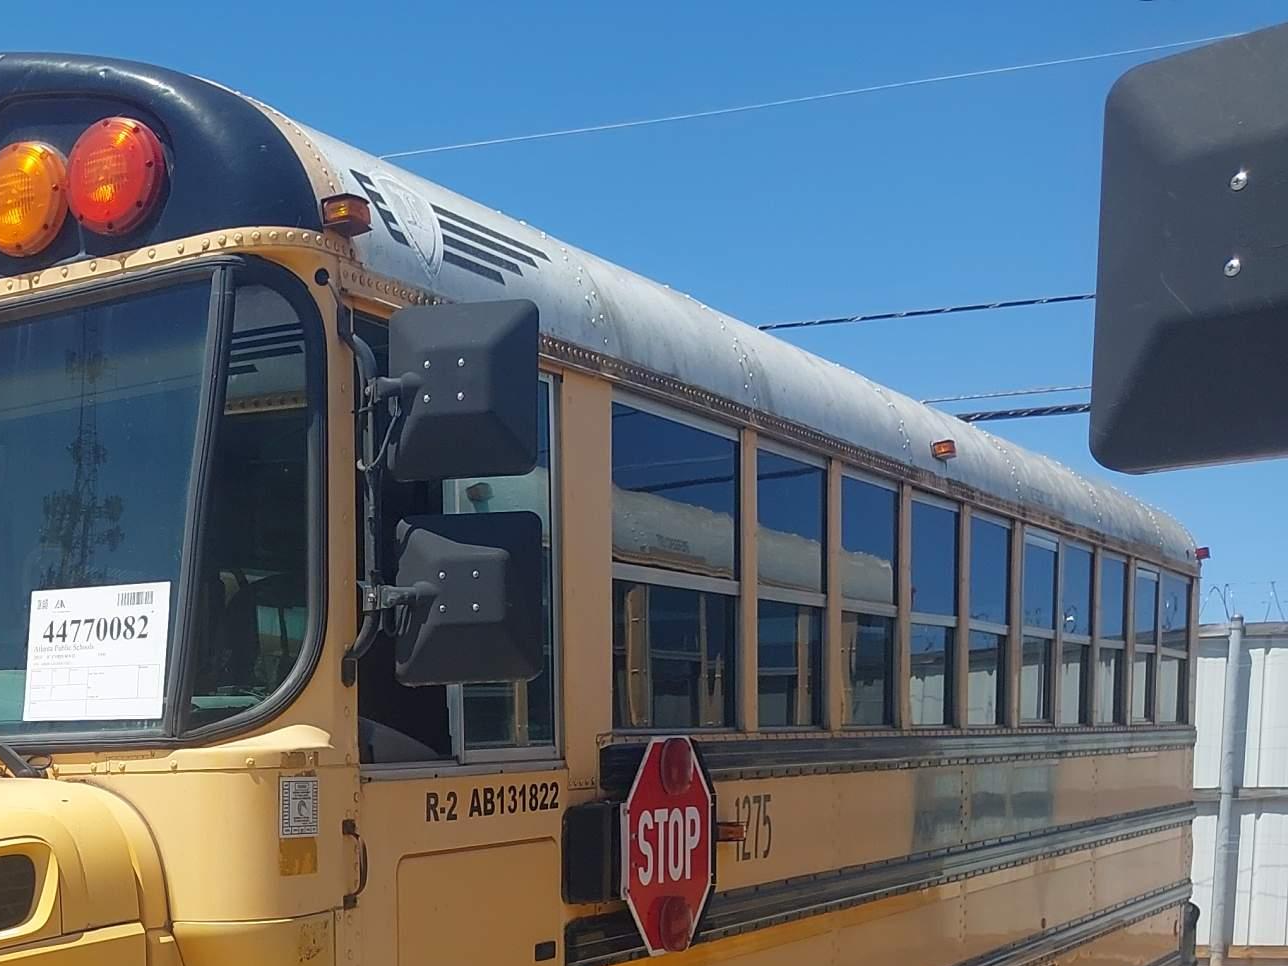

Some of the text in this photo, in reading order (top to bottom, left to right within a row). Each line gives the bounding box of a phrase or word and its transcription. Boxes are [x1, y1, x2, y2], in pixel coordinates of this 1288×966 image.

[42, 615, 149, 643] 44770082
[425, 781, 559, 822] R-2 AB131822
[735, 794, 772, 862] 1275
[638, 806, 701, 887] STOP
